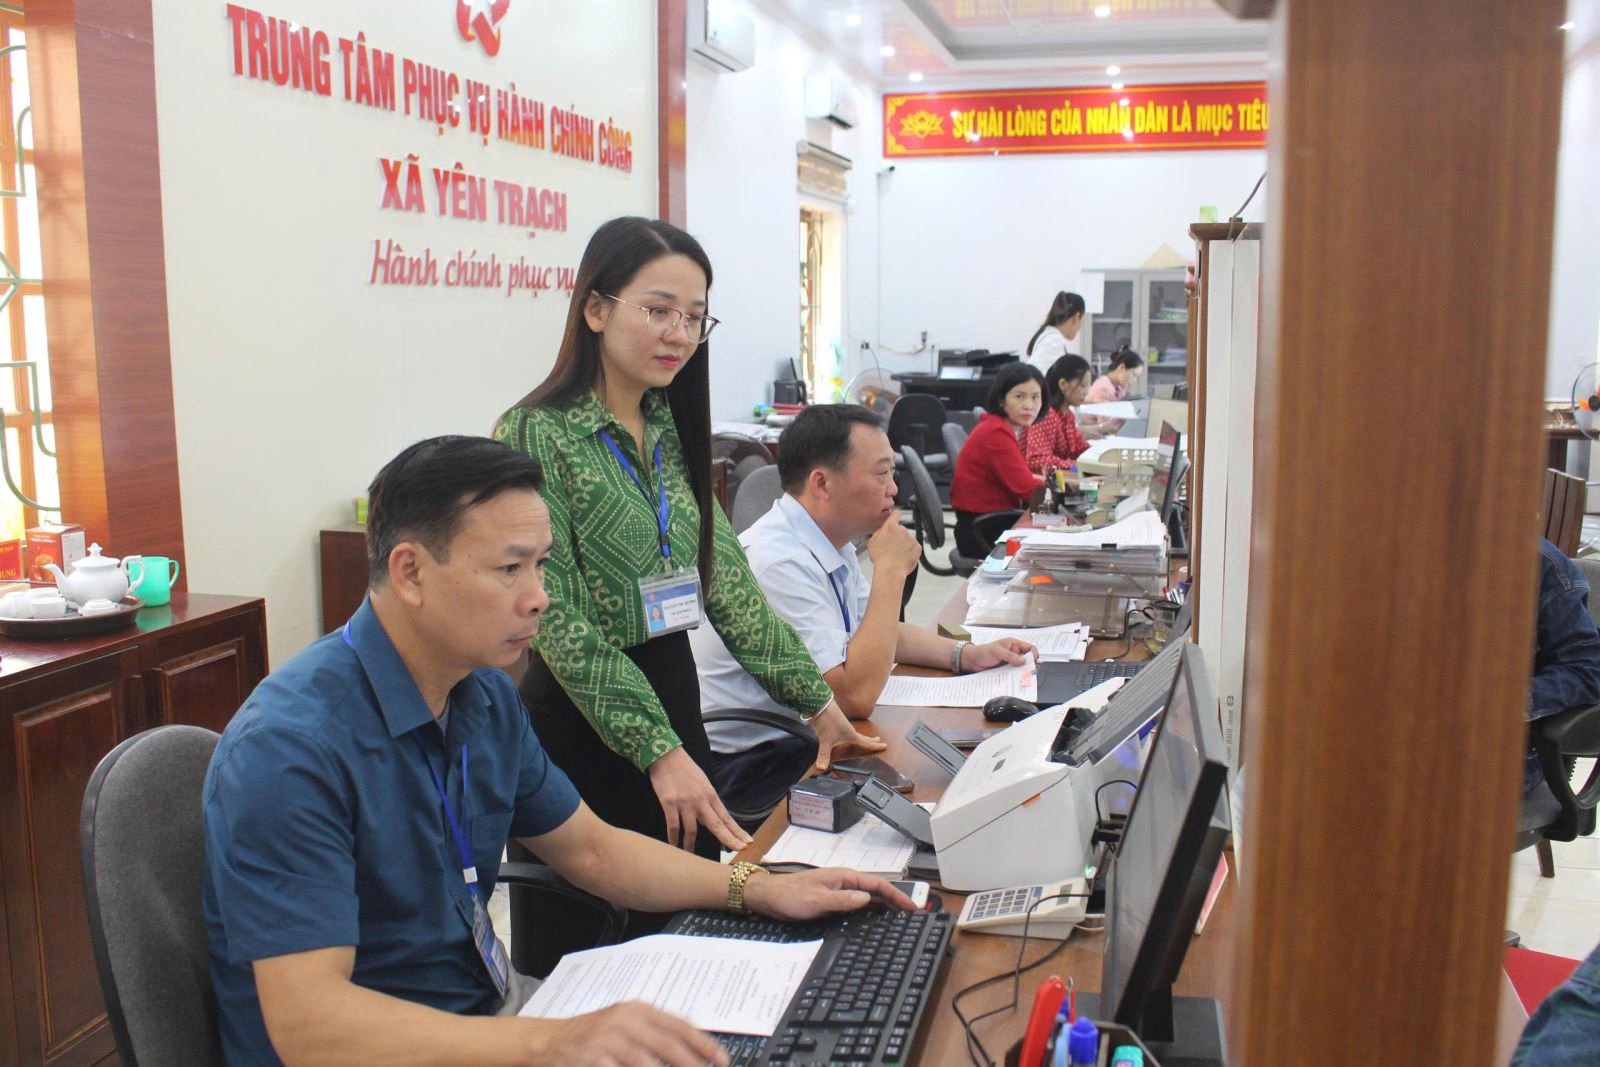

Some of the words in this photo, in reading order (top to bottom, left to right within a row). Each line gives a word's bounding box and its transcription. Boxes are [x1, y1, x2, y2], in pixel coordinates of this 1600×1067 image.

[227, 3, 331, 96] TRUNG
[338, 31, 396, 112] TÂM
[403, 57, 460, 135] PHỤC
[465, 78, 492, 146] VỤ
[497, 82, 545, 150] HÀNH
[550, 103, 595, 163] CHÍNH
[598, 117, 633, 173] CÔNG
[952, 109, 977, 143] SỰ
[977, 106, 1004, 138] HÀI
[1006, 105, 1047, 138] LÒNG
[1050, 100, 1083, 136] CỦA
[1086, 101, 1131, 134] NHÂN
[1134, 98, 1170, 133] DÂN
[1171, 99, 1193, 133] LÀ
[1197, 103, 1233, 137] MỤC
[380, 153, 425, 213] XÃ
[433, 162, 487, 221] YÊN
[494, 180, 568, 238] TRẠCH
[370, 238, 439, 286] Hành
[445, 249, 503, 289] chính
[508, 255, 552, 298] phục
[556, 266, 576, 297] vụ
